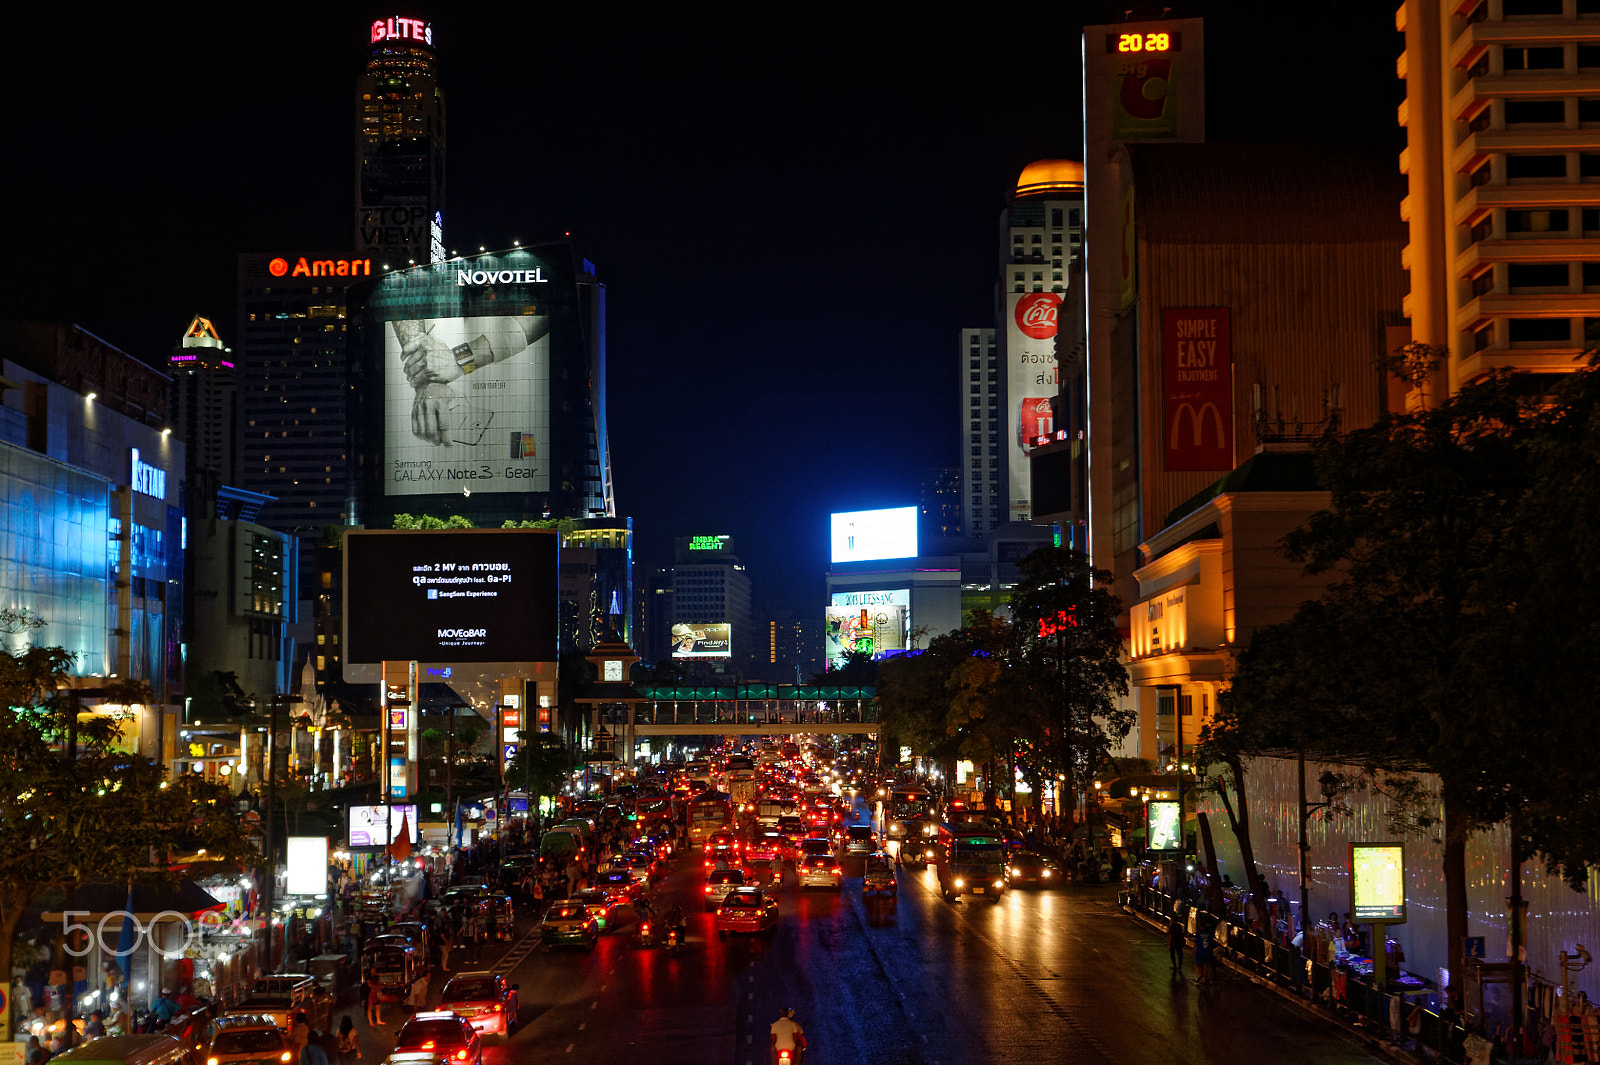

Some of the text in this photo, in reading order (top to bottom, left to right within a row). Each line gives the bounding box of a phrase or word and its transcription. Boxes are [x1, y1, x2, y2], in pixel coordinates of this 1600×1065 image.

[1118, 32, 1169, 52] 20 28
[360, 227, 422, 245] VIEW
[292, 257, 371, 277] Amari
[457, 266, 548, 286] NOVOTEL
[1176, 319, 1217, 338] SIMPLE
[1177, 340, 1217, 368] EASY
[1177, 369, 1218, 382] ENJOYMENT
[131, 447, 166, 500] ISETAN
[394, 460, 432, 470] Samsung
[394, 469, 444, 482] GALAXY
[447, 468, 477, 480] Note
[478, 465, 494, 479] 3
[505, 467, 539, 479] Gear
[434, 563, 440, 572] 2
[442, 563, 456, 572] MV
